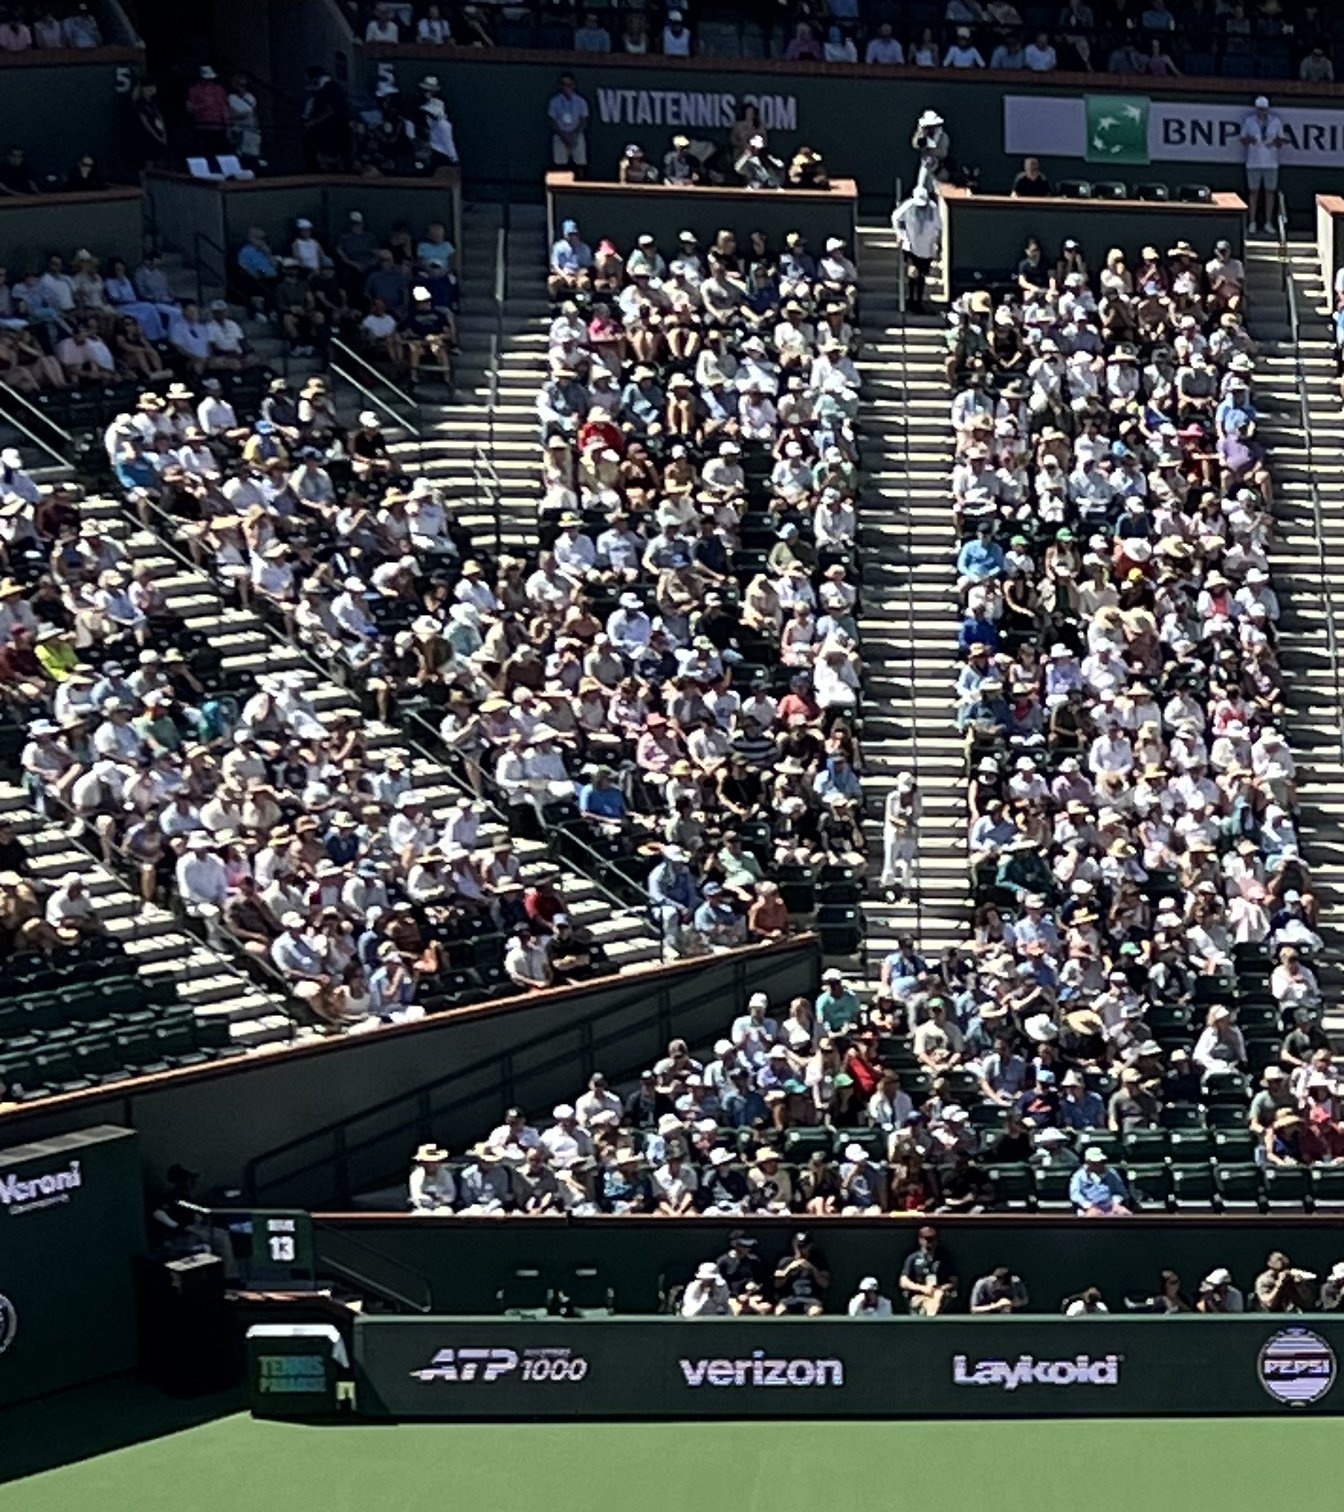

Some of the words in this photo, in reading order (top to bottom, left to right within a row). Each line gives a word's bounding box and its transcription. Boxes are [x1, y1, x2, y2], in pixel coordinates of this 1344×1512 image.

[1162, 117, 1242, 147] BNP
[269, 1235, 295, 1262] 13
[409, 1348, 519, 1381] ATP
[520, 1358, 588, 1381] 1000
[679, 1350, 844, 1386] verizon
[953, 1354, 1119, 1390] Laykold
[1263, 1359, 1330, 1374] PEPSI
